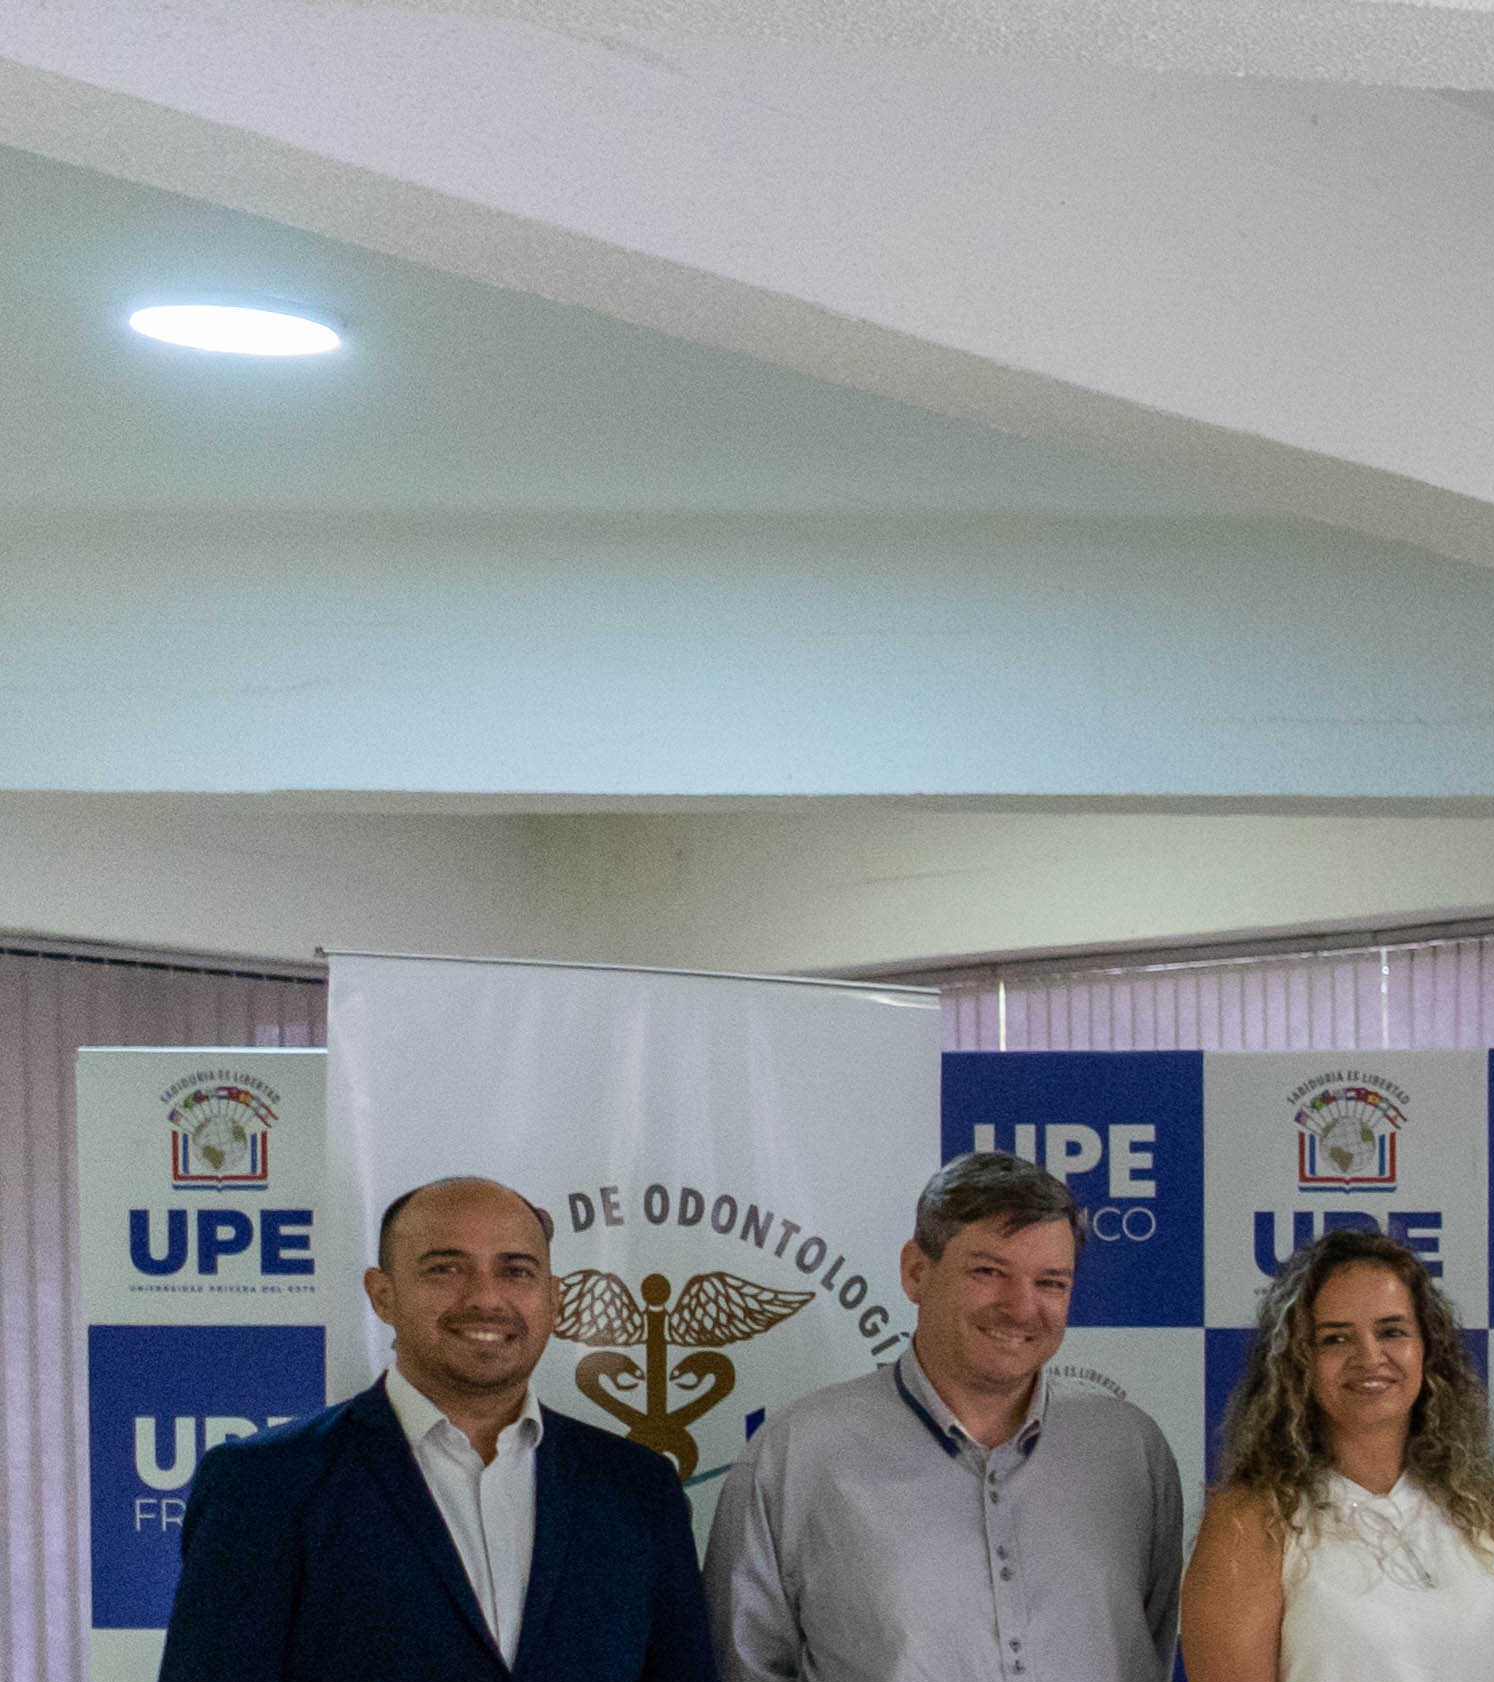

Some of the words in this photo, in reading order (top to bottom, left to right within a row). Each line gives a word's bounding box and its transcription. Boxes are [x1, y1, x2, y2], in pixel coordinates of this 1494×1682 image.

[129, 1209, 316, 1276] UPE
[567, 1183, 625, 1233] DE
[642, 1183, 912, 1370] ODONTOLOGÍ
